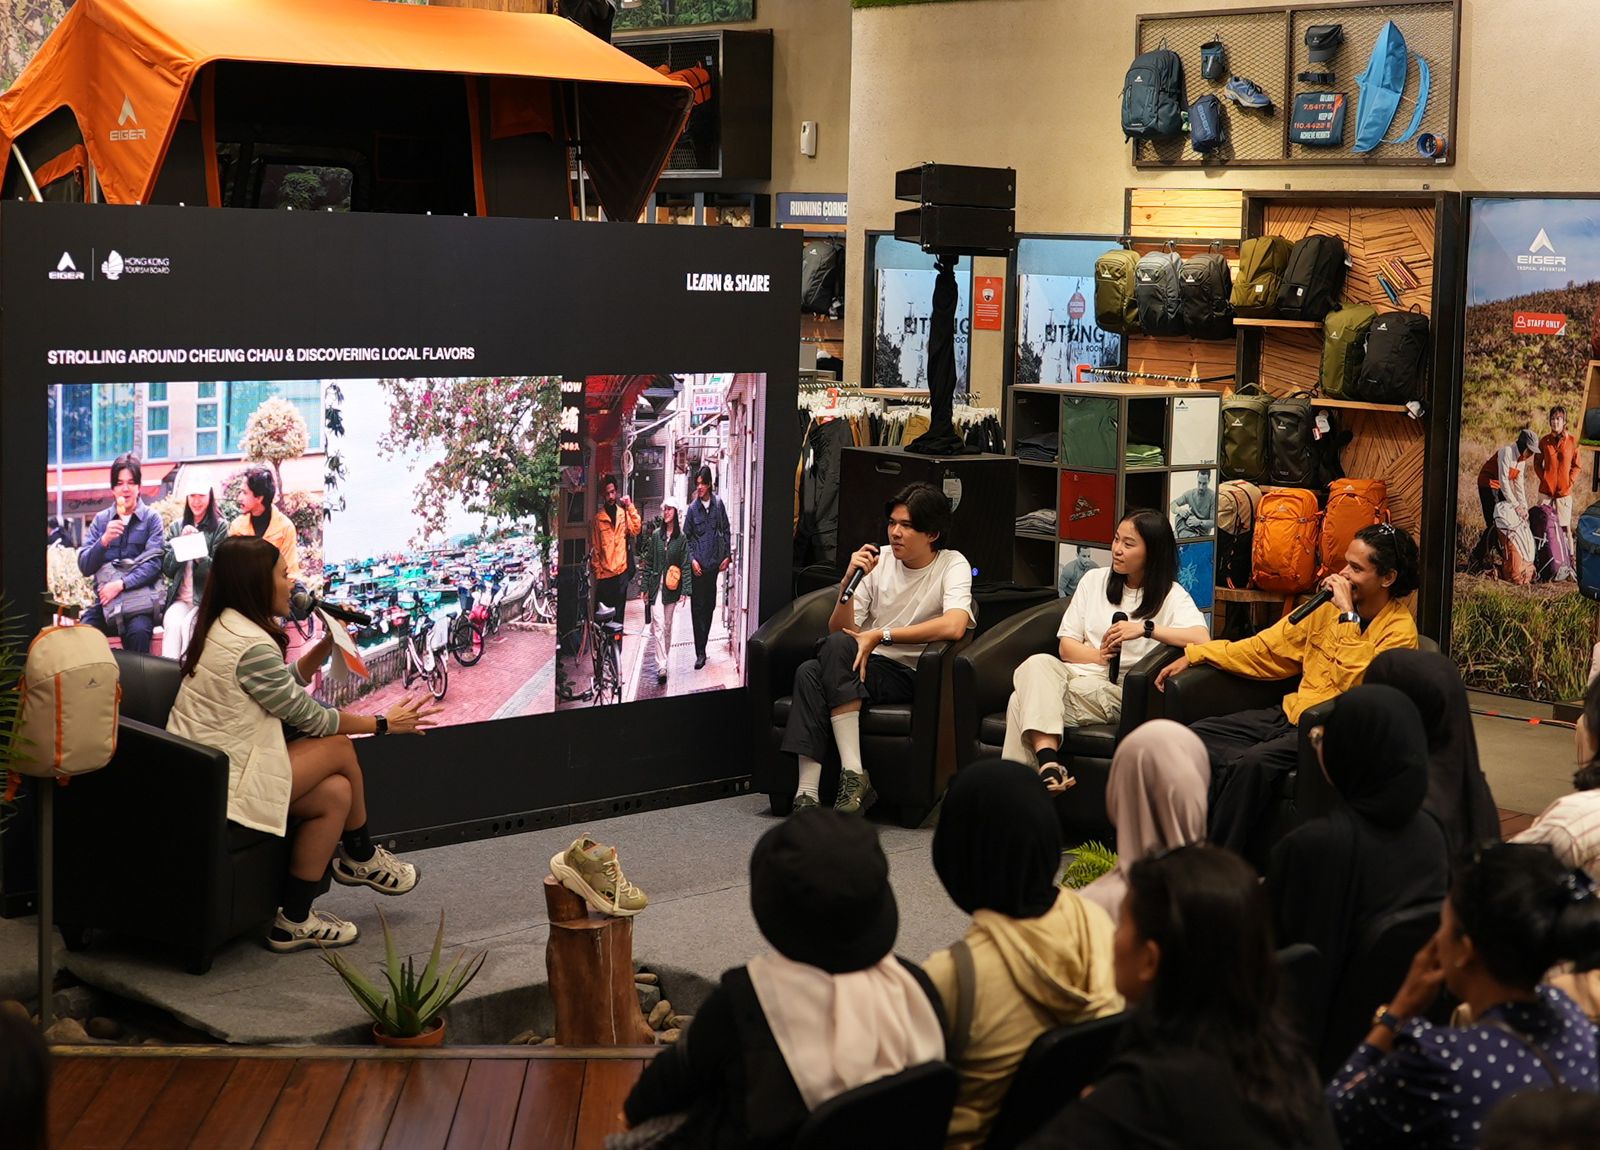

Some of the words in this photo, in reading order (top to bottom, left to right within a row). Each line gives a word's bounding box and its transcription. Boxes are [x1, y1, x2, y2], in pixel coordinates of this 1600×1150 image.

[109, 129, 146, 141] EIGER
[789, 201, 822, 216] RUNNING
[822, 201, 848, 217] CORNE
[125, 258, 147, 266] HONG
[147, 258, 170, 266] KONG
[1517, 255, 1566, 265] EIGER
[125, 266, 150, 274] TOURISM
[48, 271, 85, 280] EIGER
[686, 273, 722, 291] LEARN
[723, 273, 735, 292] &
[735, 274, 770, 292] SHARE
[1527, 319, 1545, 328] STAFF
[1546, 320, 1561, 329] ONLY
[47, 349, 127, 365] STROLLING
[128, 349, 188, 364] AROUND
[189, 348, 246, 363] CHEUNG
[246, 348, 284, 362] CHAU
[285, 348, 295, 362] &
[296, 347, 380, 362] DISCOVERING
[381, 347, 422, 361] LOCAL
[422, 346, 475, 361] FLAVORS
